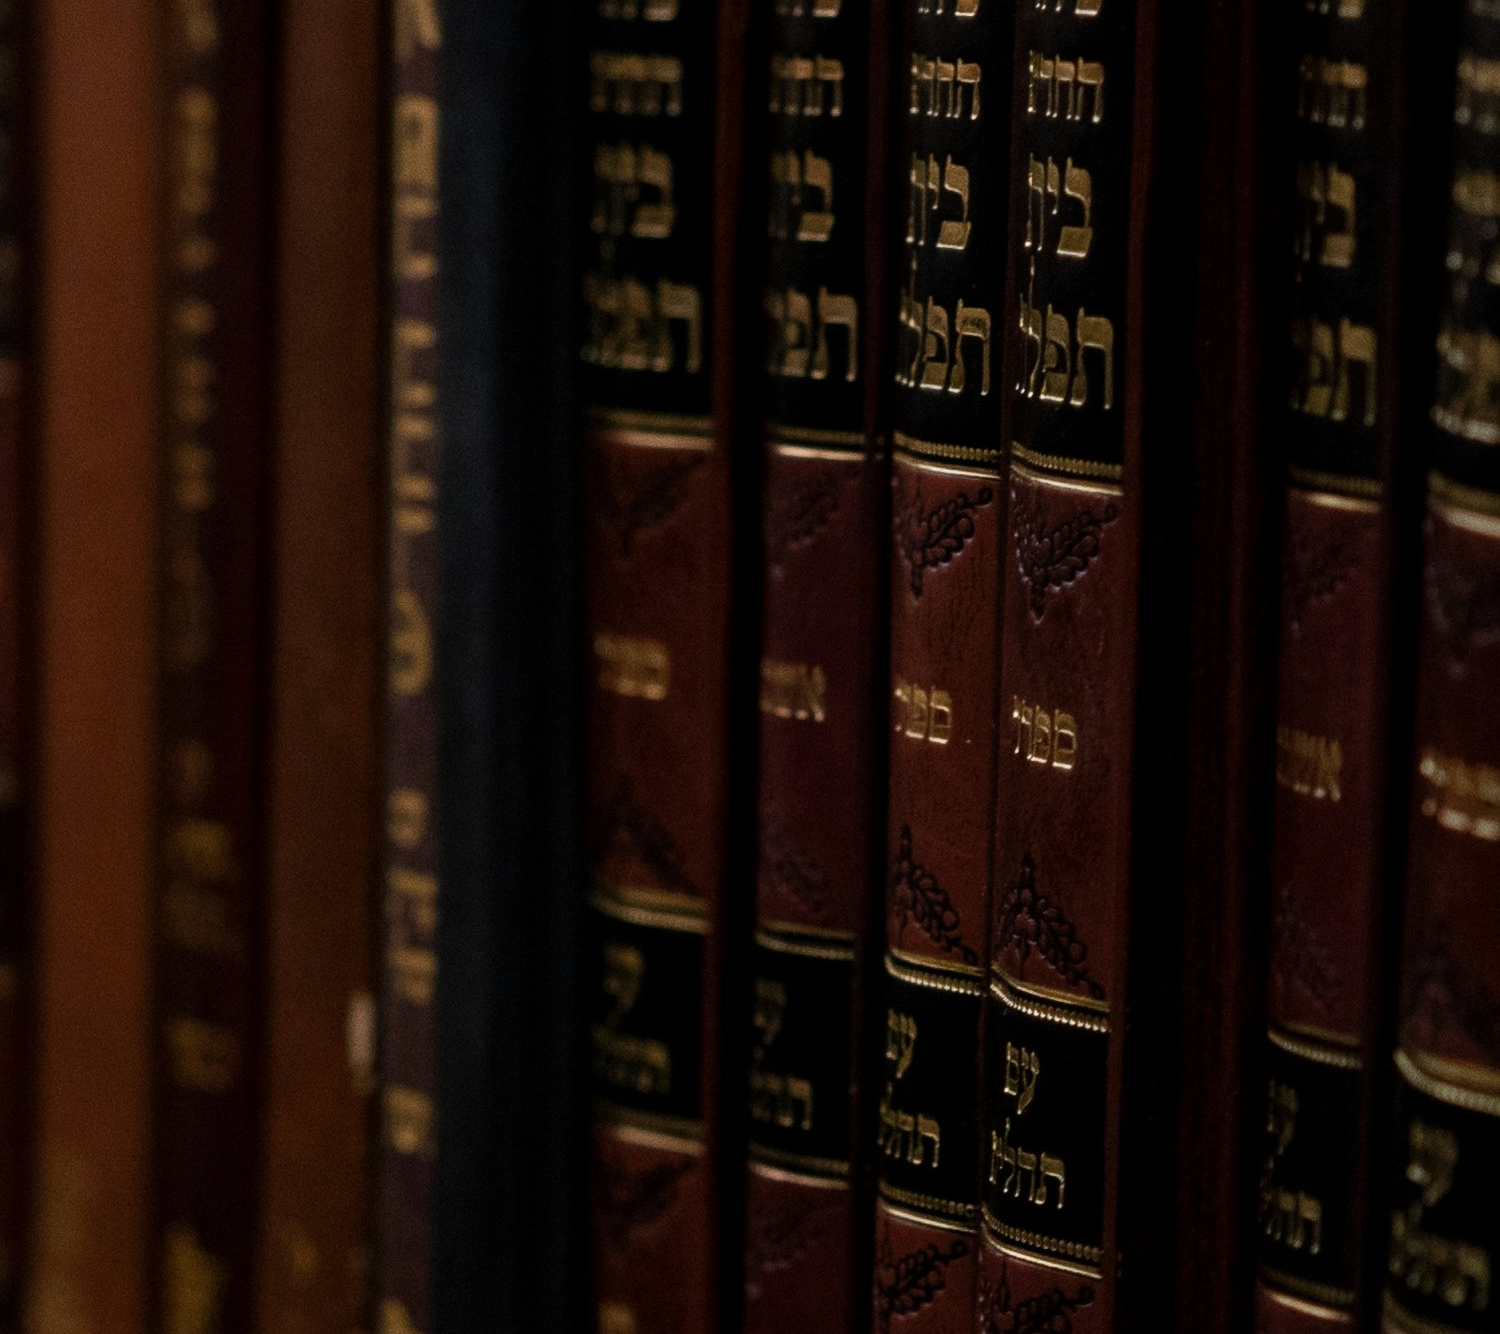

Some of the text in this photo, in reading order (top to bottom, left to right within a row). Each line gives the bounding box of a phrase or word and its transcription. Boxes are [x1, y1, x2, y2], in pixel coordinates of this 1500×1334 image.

[906, 153, 970, 251] בית
[1024, 153, 1093, 258] בית
[895, 253, 990, 396] תפלה
[1014, 255, 1114, 410] תפלה
[1011, 694, 1078, 770] ספרד
[1004, 1040, 1040, 1115] עם
[989, 1116, 1065, 1209] תהלים
